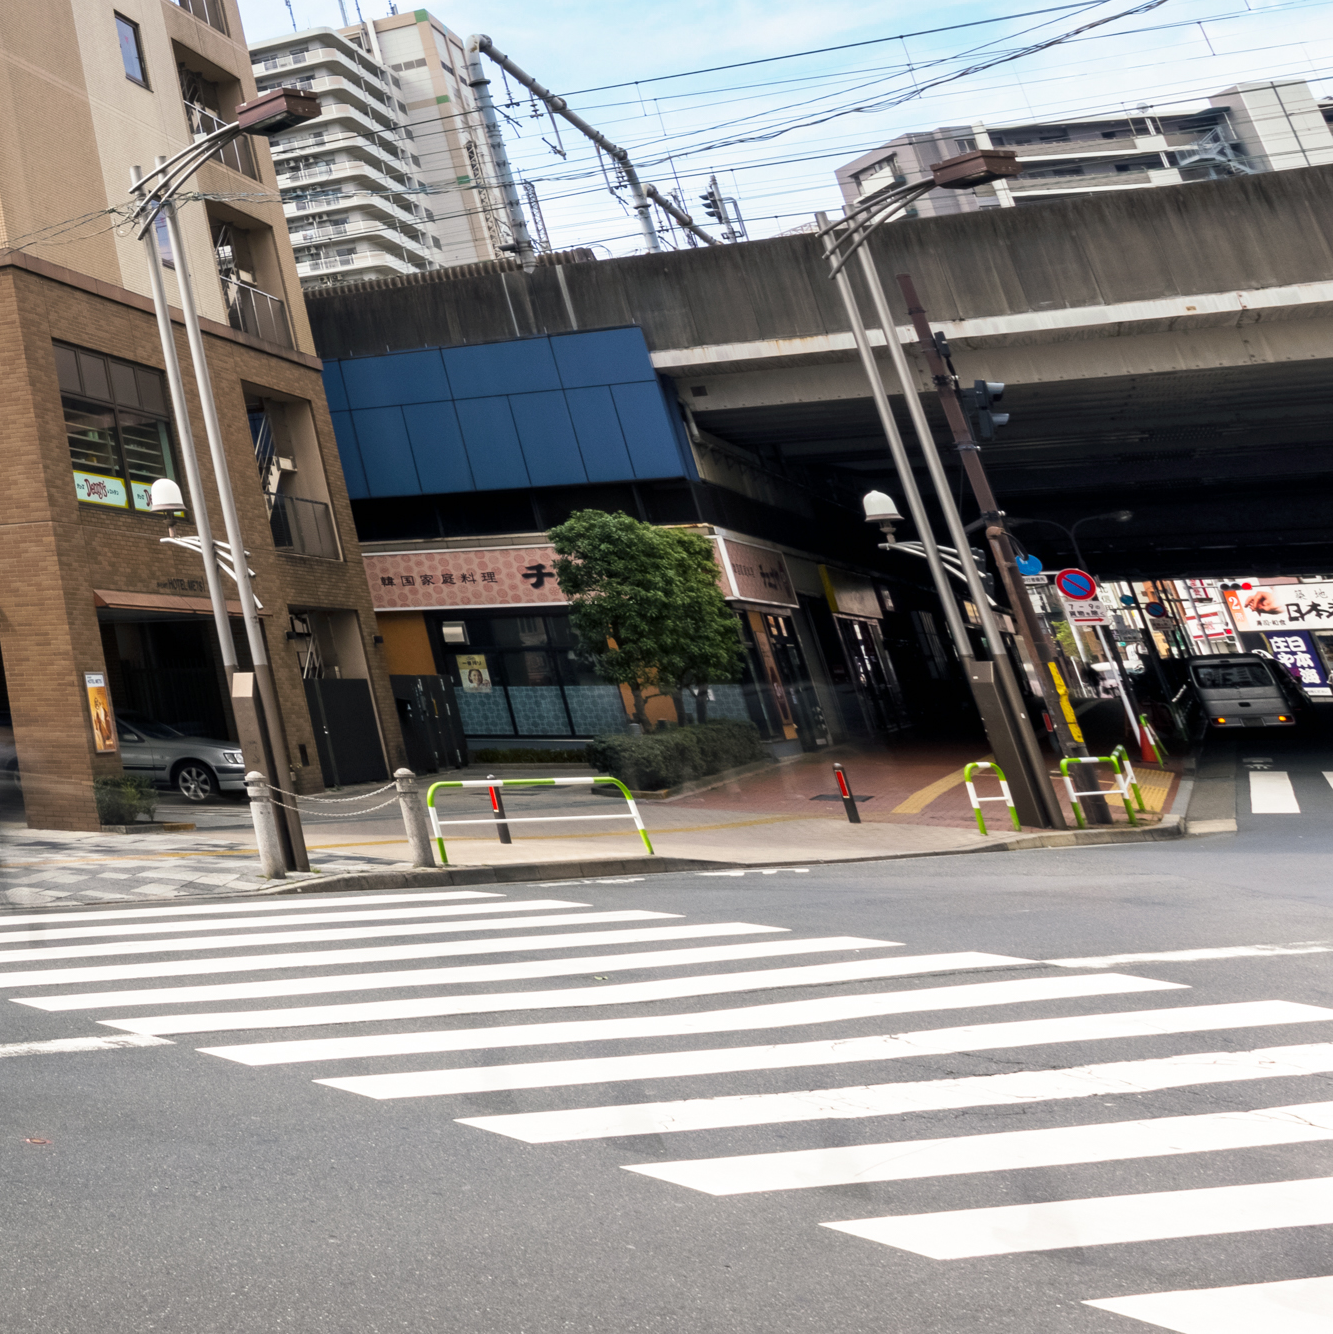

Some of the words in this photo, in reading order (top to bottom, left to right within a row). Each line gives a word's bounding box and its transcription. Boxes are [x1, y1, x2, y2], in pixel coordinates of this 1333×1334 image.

[84, 478, 108, 500] Denny's
[380, 571, 498, 588] 韓国家庭料理
[1288, 635, 1321, 684] 日本海
